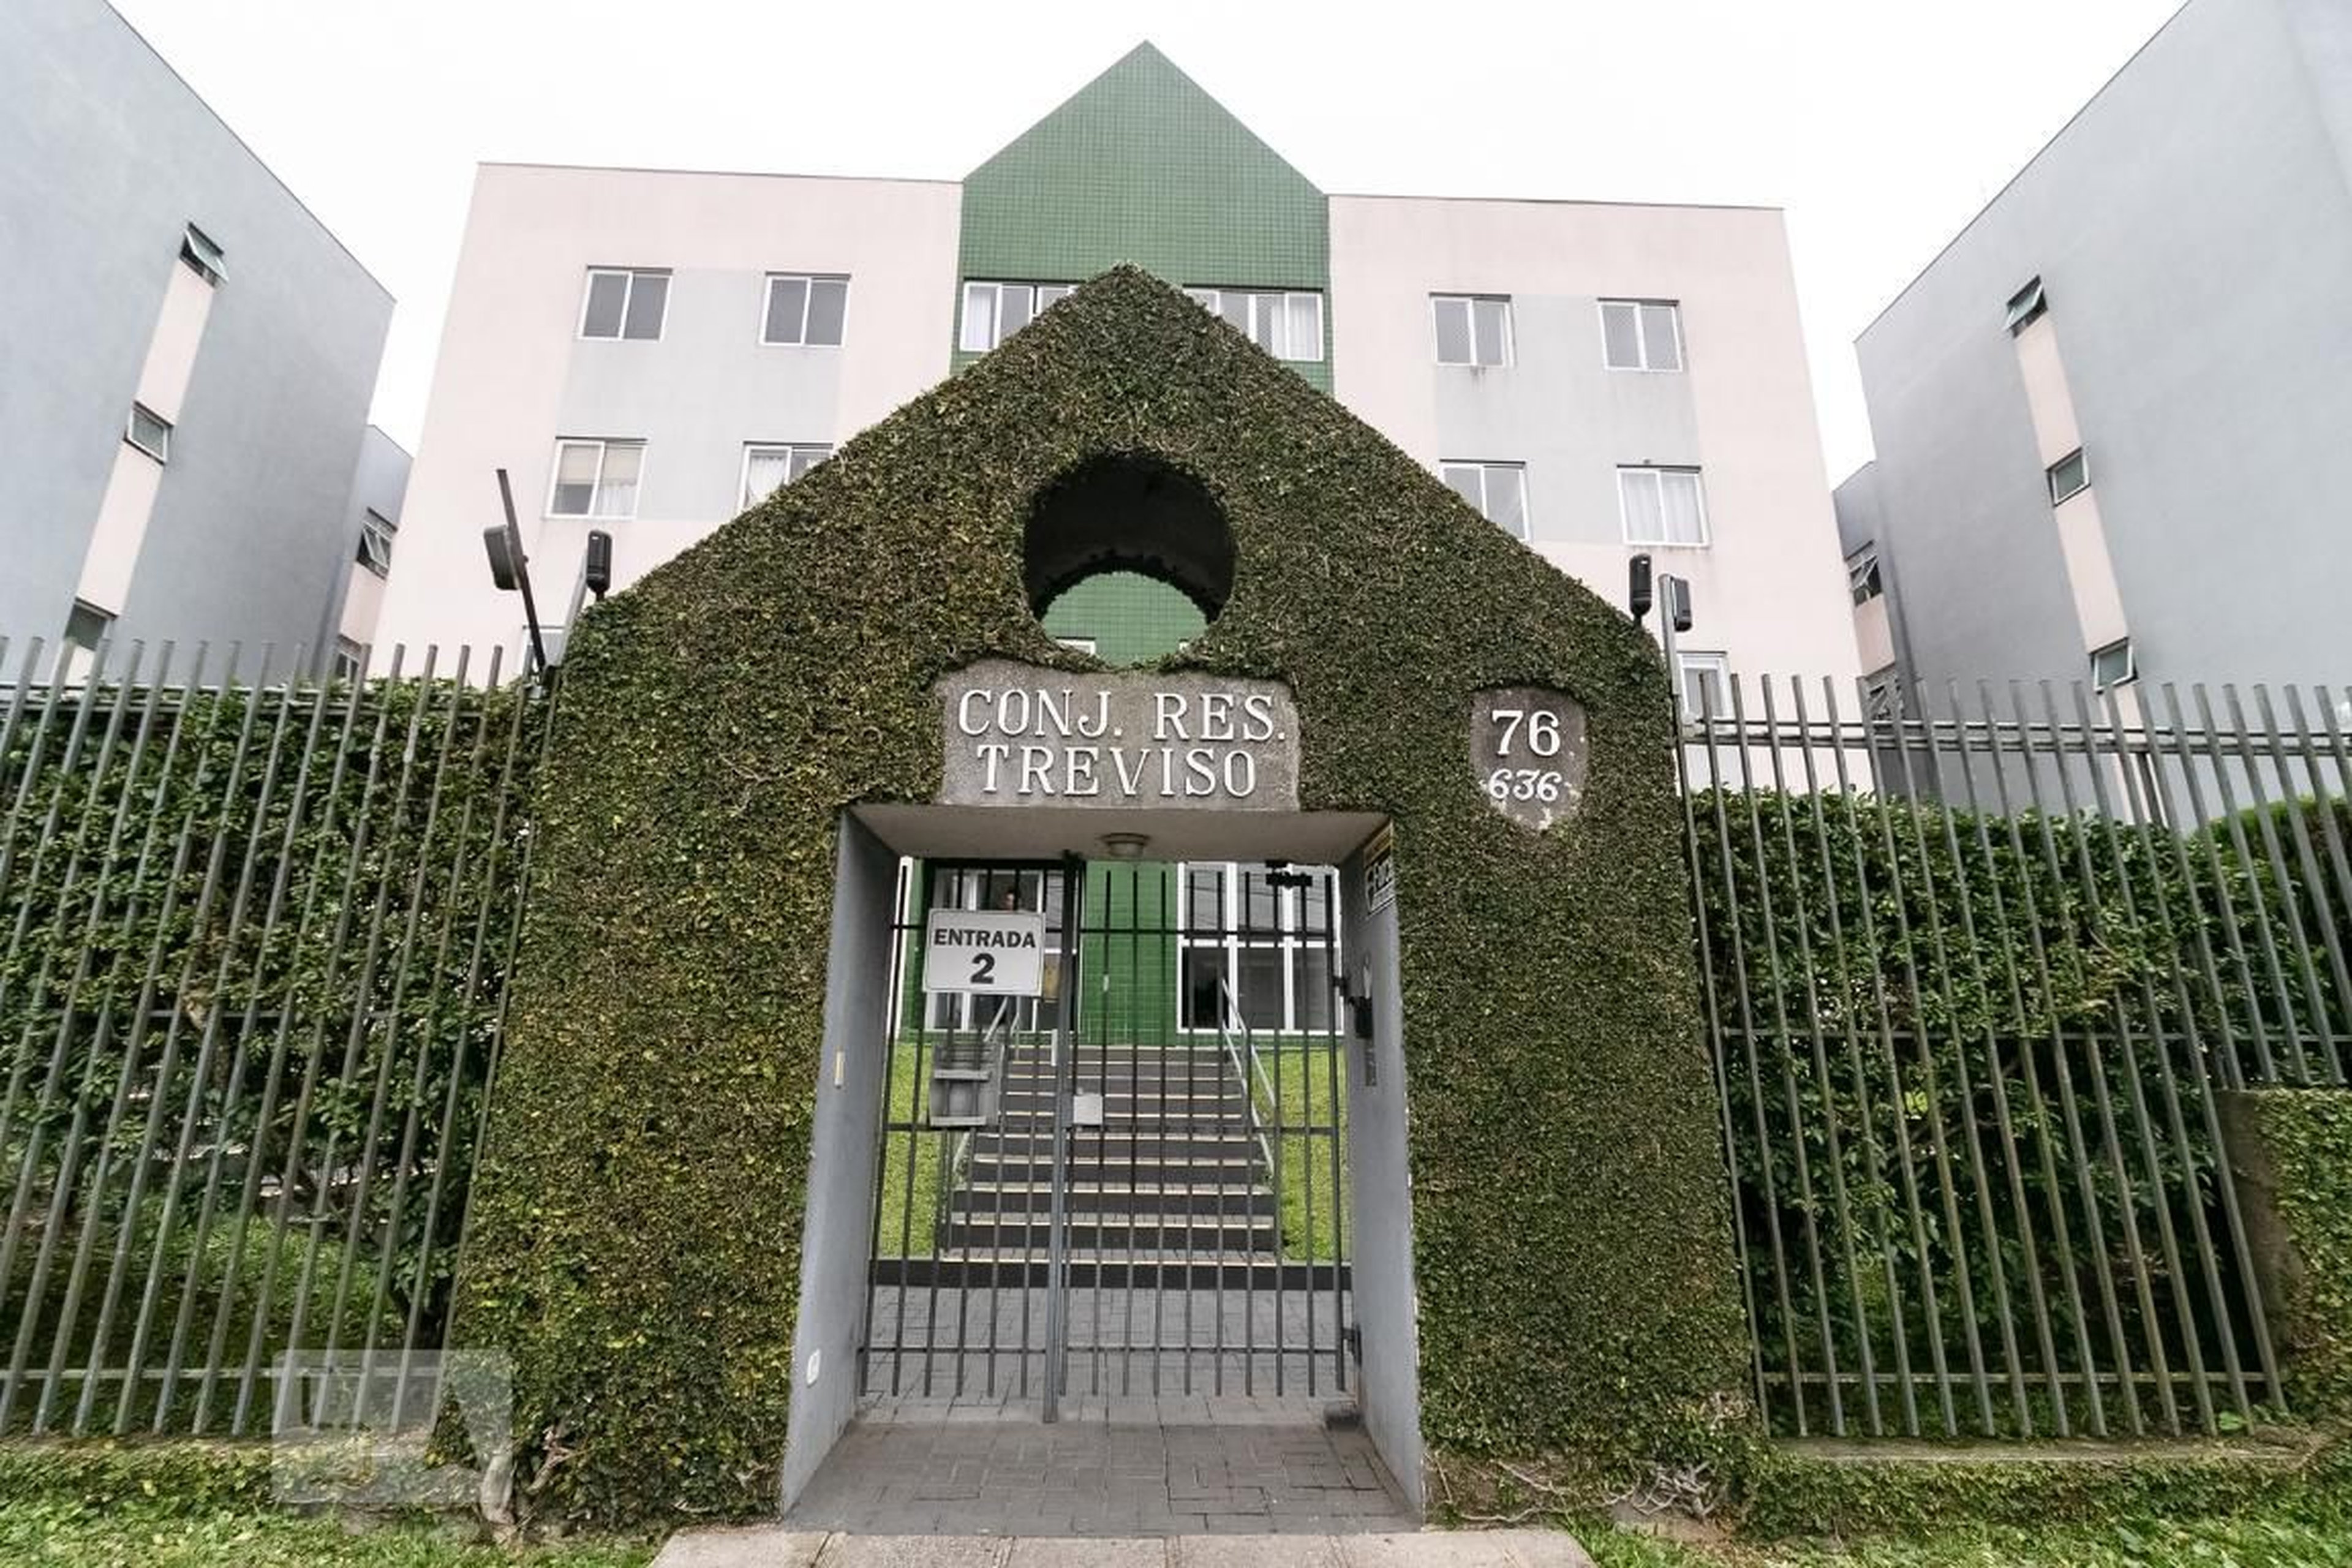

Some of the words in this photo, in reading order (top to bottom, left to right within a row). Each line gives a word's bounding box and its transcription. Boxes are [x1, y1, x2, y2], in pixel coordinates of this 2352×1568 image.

[959, 688, 1123, 737] CONJ.
[1153, 692, 1286, 741] RES.
[1491, 709, 1561, 757] 76
[976, 744, 1256, 797] TREVISO
[1488, 768, 1562, 802] 636
[933, 927, 1036, 949] ENTRADA
[970, 952, 995, 985] 2
